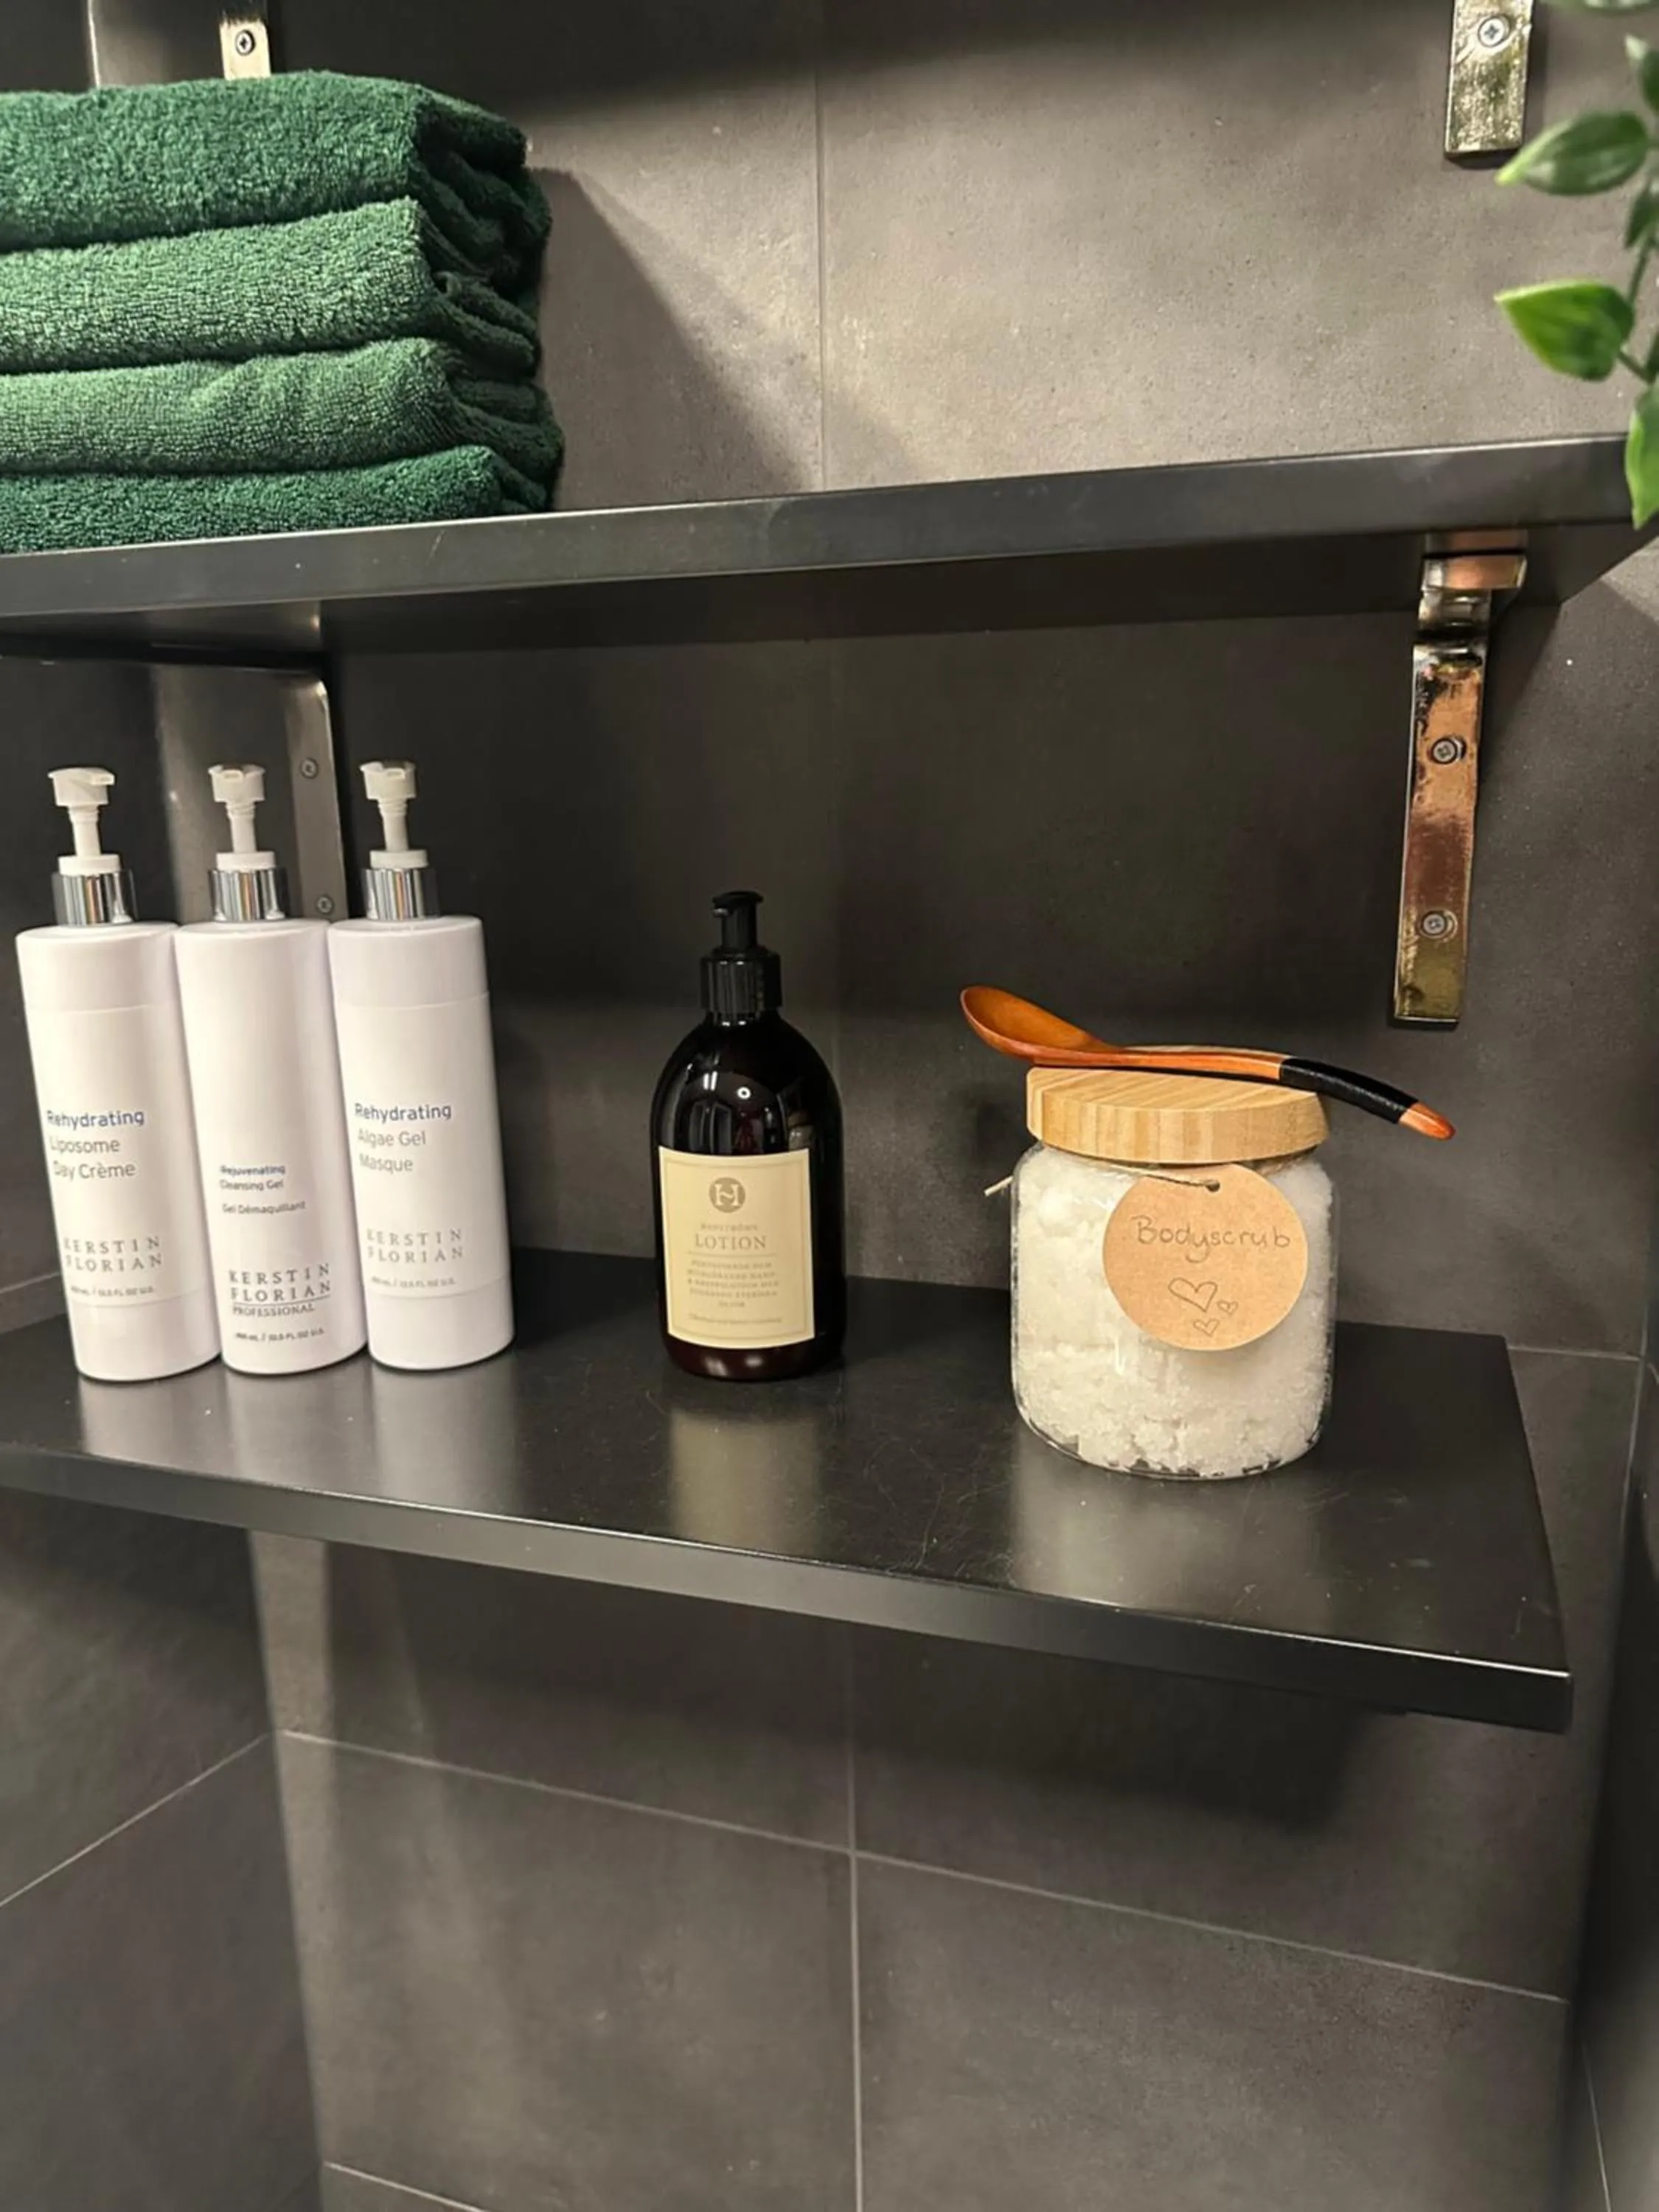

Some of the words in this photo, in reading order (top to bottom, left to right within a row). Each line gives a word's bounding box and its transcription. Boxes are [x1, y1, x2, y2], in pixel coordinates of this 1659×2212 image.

[46, 1110, 145, 1130] Rehydrating
[354, 1103, 452, 1123] Rehydrating
[358, 1129, 394, 1148] Algae
[398, 1131, 426, 1147] Gel
[78, 1163, 136, 1179] Crème
[359, 1153, 413, 1174] Masque
[695, 1234, 768, 1251] LOTION
[1131, 1215, 1292, 1263] Bodyscrub
[229, 1263, 329, 1284] KERSTIN
[231, 1281, 331, 1303] FLORIAN
[233, 1303, 316, 1317] PROFESSIONAL
